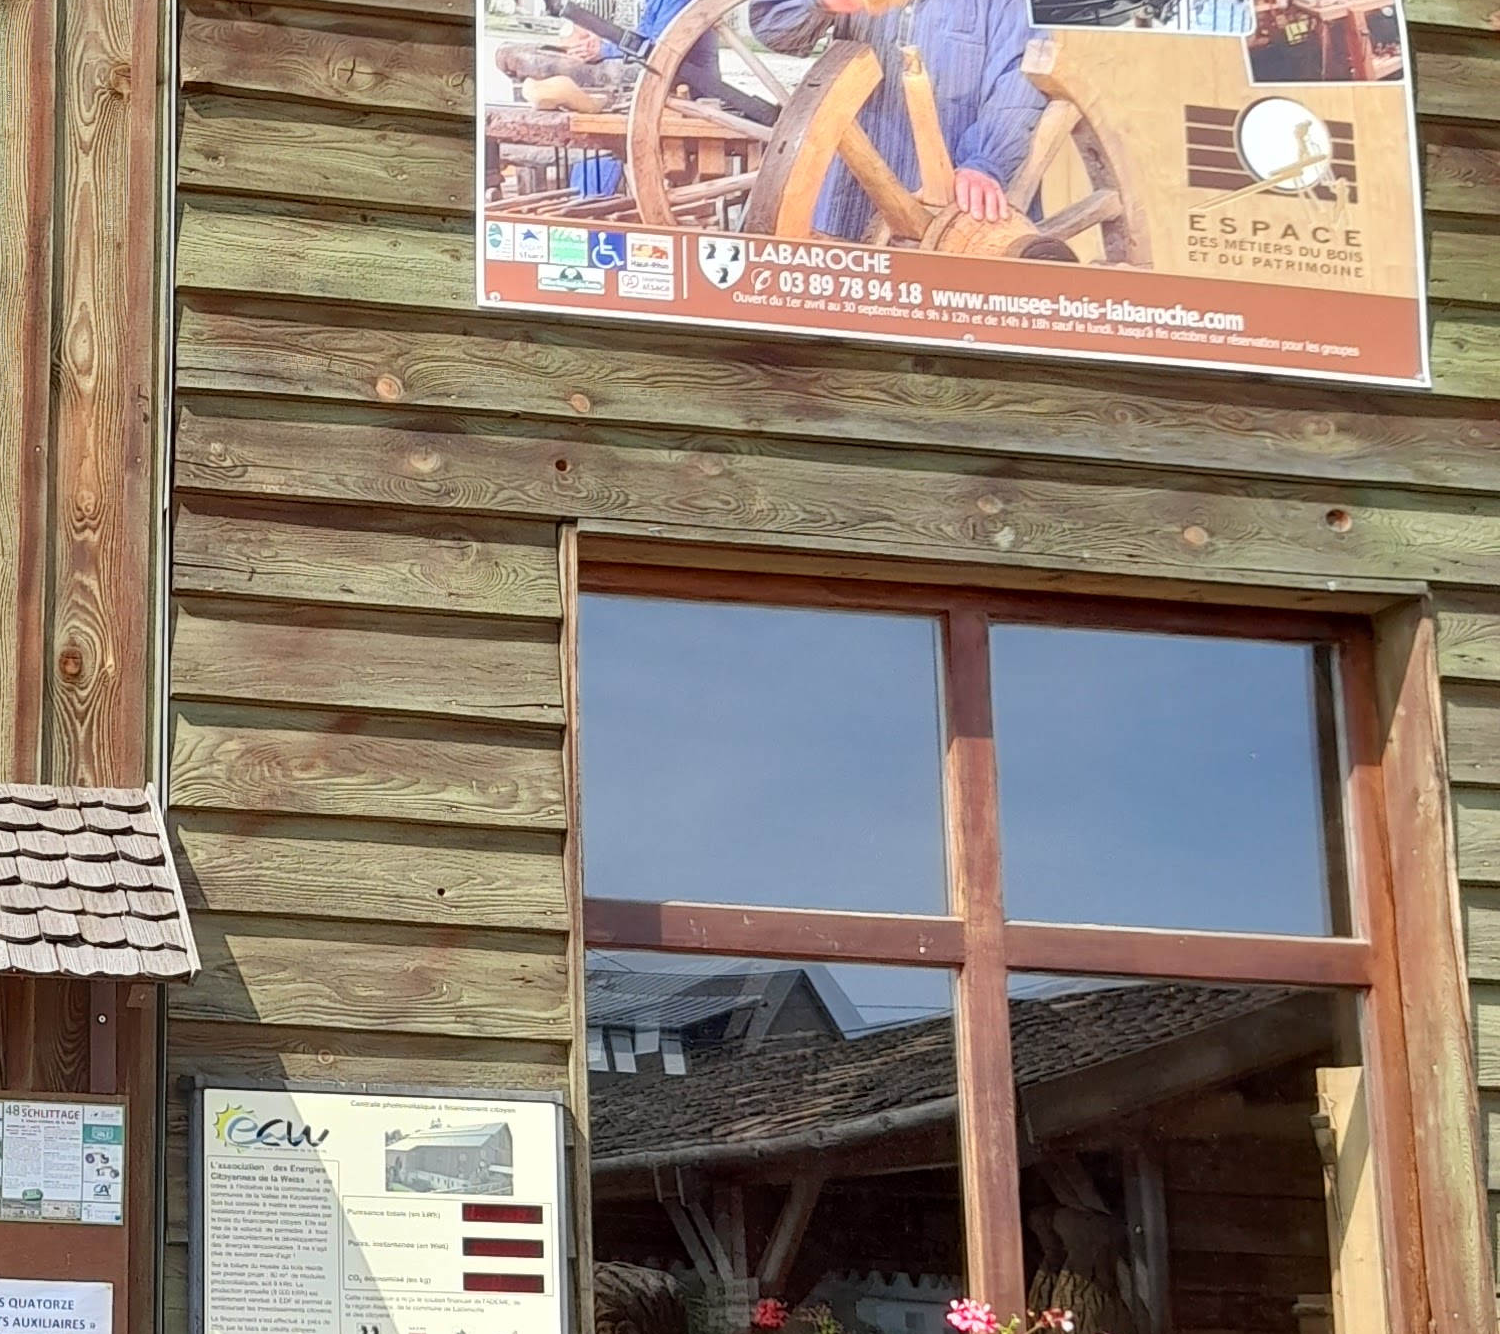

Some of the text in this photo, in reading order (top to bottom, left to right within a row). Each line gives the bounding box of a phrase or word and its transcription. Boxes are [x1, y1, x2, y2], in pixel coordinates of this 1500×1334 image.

[1188, 214, 1363, 248] ESPACE
[748, 240, 892, 275] LABAROCHE
[1187, 235, 1364, 263] DES MÉTIERS DU BOIS
[1188, 250, 1365, 279] ET DU PATRIMOINE
[779, 270, 1245, 332] 03 89 78 94 18 www.musee-bois-labaroche.com
[732, 291, 767, 305] Ouvert
[769, 294, 783, 307] du
[804, 298, 825, 310] avril
[827, 302, 841, 312] au
[842, 302, 855, 313] 30
[857, 303, 910, 319] septembre
[911, 308, 925, 320] de
[926, 308, 939, 321] 9h
[941, 310, 948, 322] à
[951, 311, 970, 324] 12h
[984, 313, 998, 326] de
[1001, 316, 1019, 328] 14h
[1021, 317, 1029, 329] à
[1031, 318, 1050, 330] 18h
[1052, 320, 1074, 332] sauf
[1170, 329, 1207, 343] octobre
[1227, 334, 1280, 349] réservation
[1320, 344, 1360, 358] groupes
[6, 1104, 80, 1120] 48 SCHLITTAGE
[210, 1161, 265, 1171] L'association
[273, 1164, 288, 1172] des
[8, 1298, 75, 1310] QUATORZE
[12, 1317, 86, 1330] AUXILIAIRES
